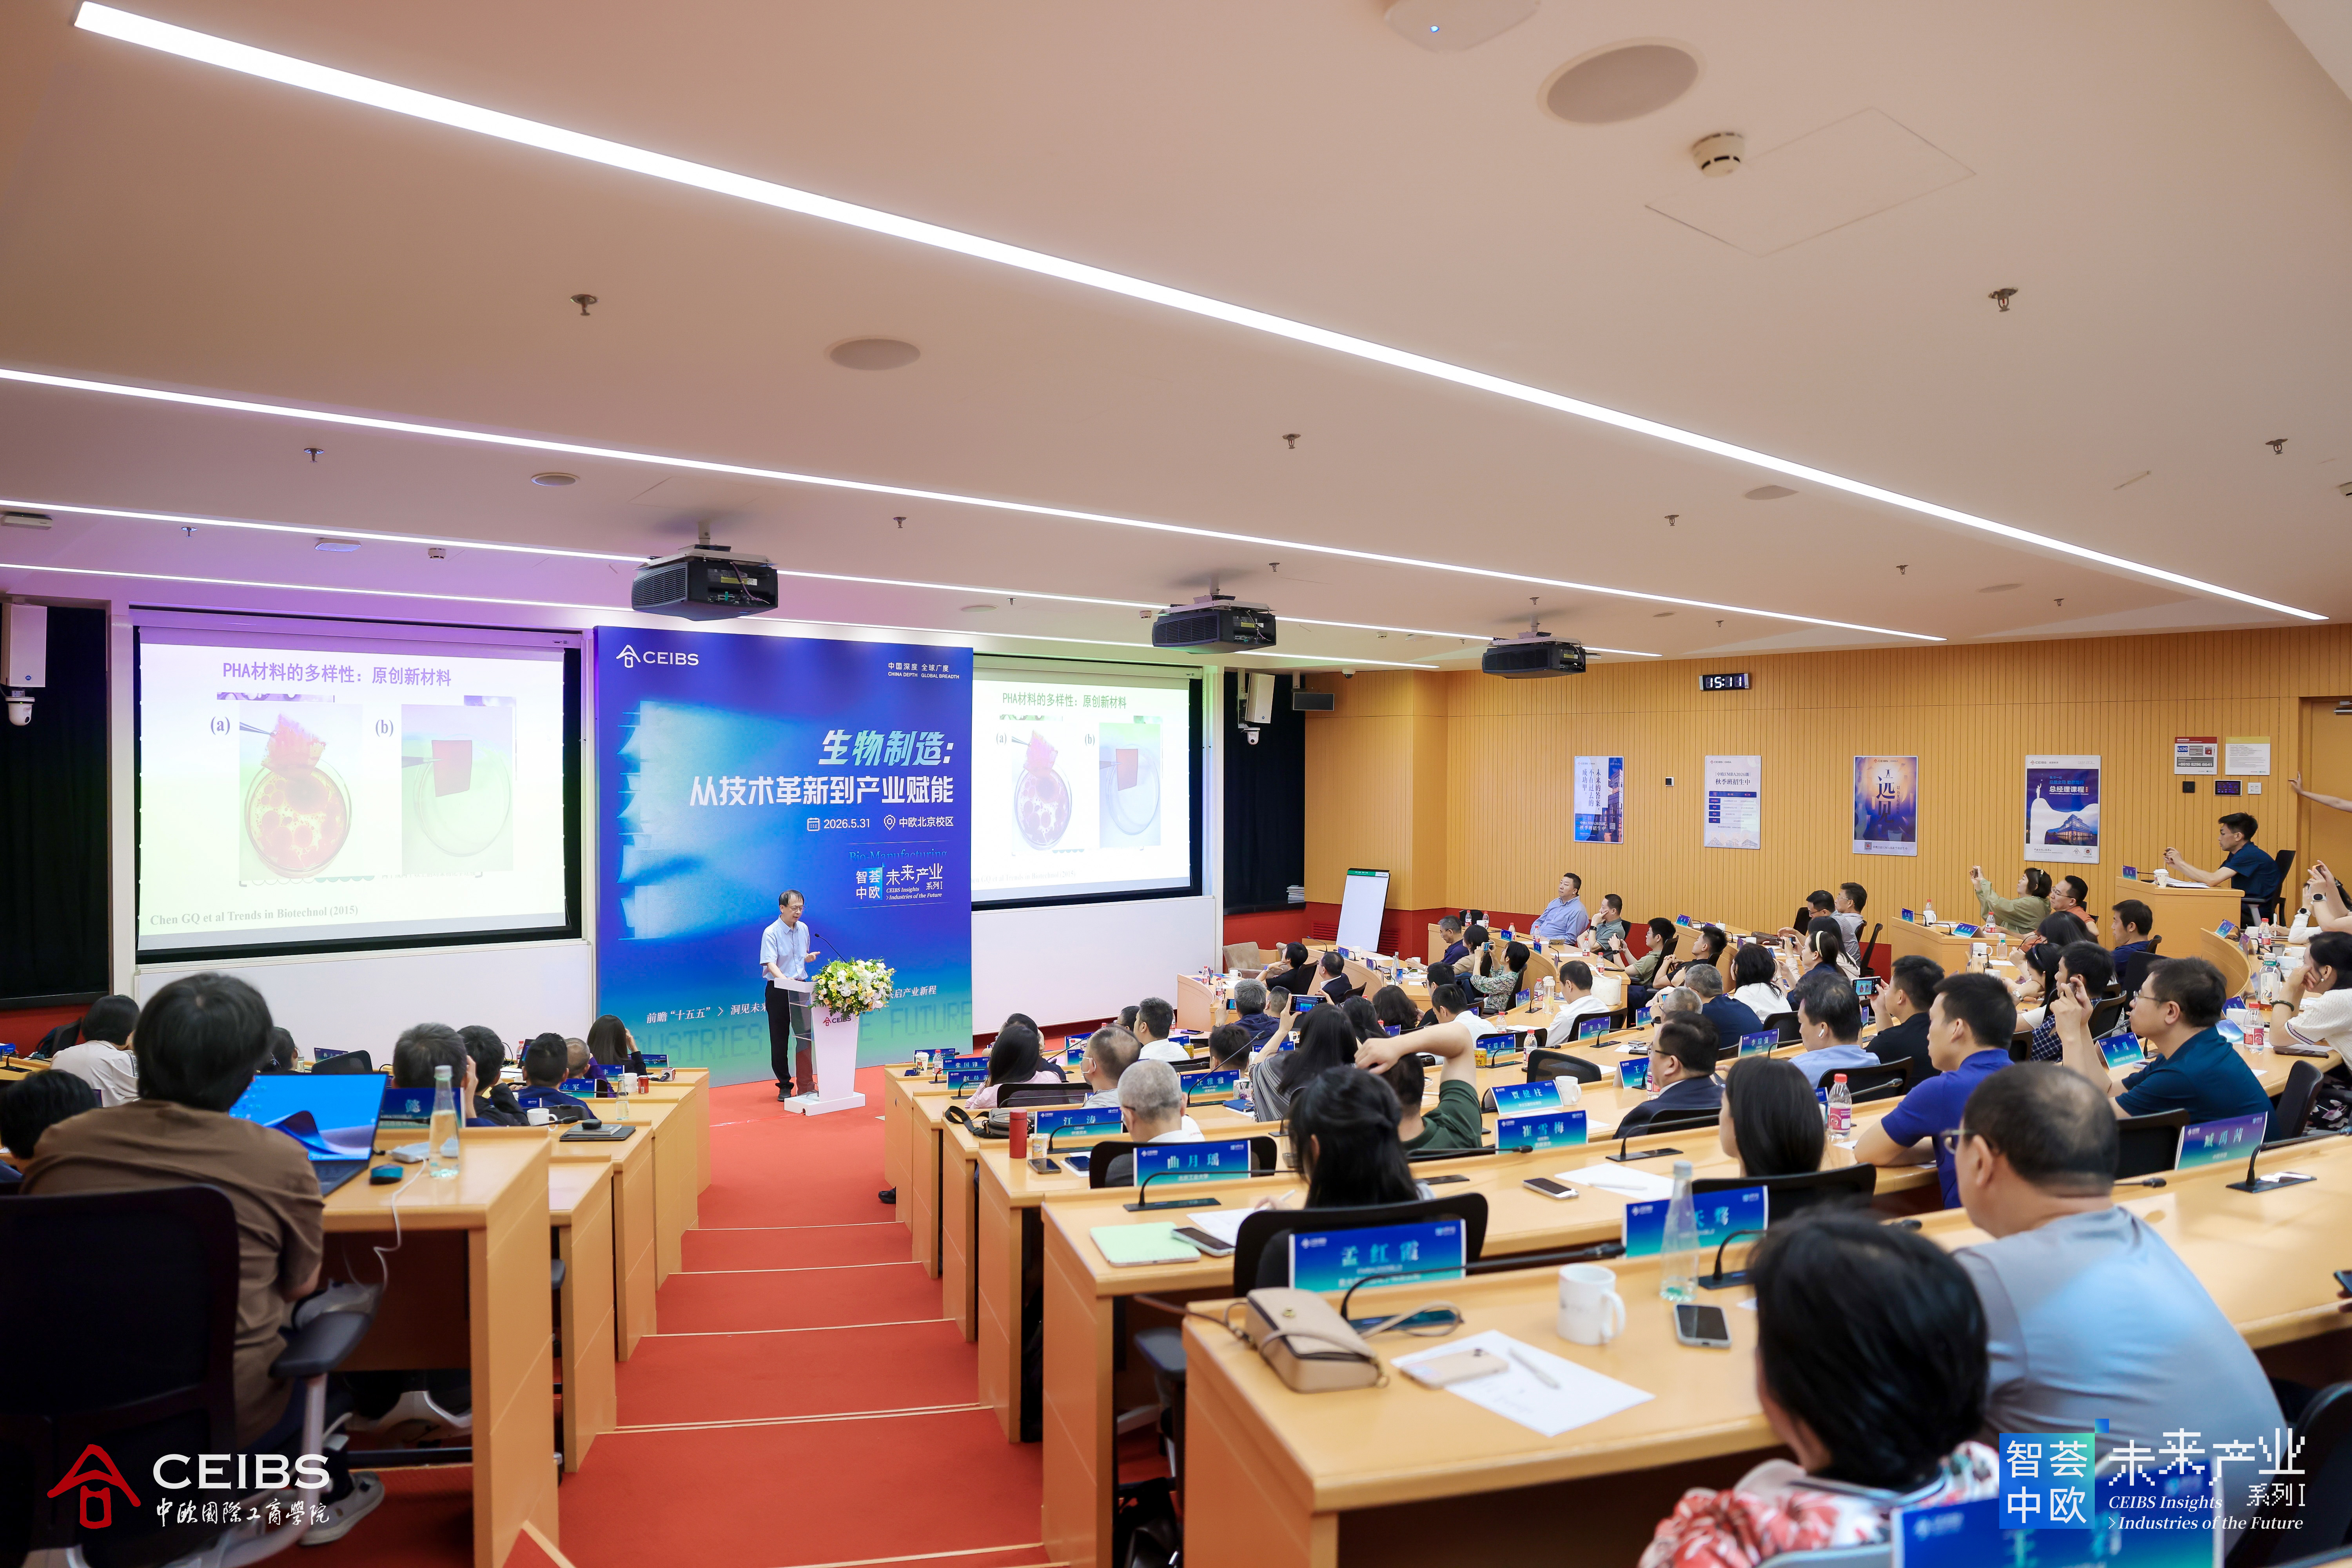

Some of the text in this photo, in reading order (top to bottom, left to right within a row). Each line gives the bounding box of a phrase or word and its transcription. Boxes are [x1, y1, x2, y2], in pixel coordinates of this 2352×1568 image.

[643, 651, 699, 666] CEIBS
[888, 662, 949, 672] 中国深度 全球广度
[223, 662, 451, 687] PHA材料的多样性：原创新材料
[1710, 676, 1742, 688] 15:11
[210, 716, 230, 735] (a)
[376, 718, 394, 737] (b)
[996, 732, 1007, 745] (a)
[1085, 734, 1095, 746] (b)
[818, 729, 954, 767] 生物制造：
[690, 776, 954, 806] 从技术革新到产业赋能
[824, 818, 870, 829] 2026.5.31
[899, 816, 954, 829] 中欧北京校区
[849, 848, 947, 861] Bio-Manufacturing
[856, 870, 880, 884] 智荟
[886, 863, 943, 885] 未来产业
[856, 886, 880, 900] 中欧
[150, 905, 358, 925] Chen GQ et al Trends in Biotechnol (2015)
[1342, 1240, 1419, 1267] 孟红霞
